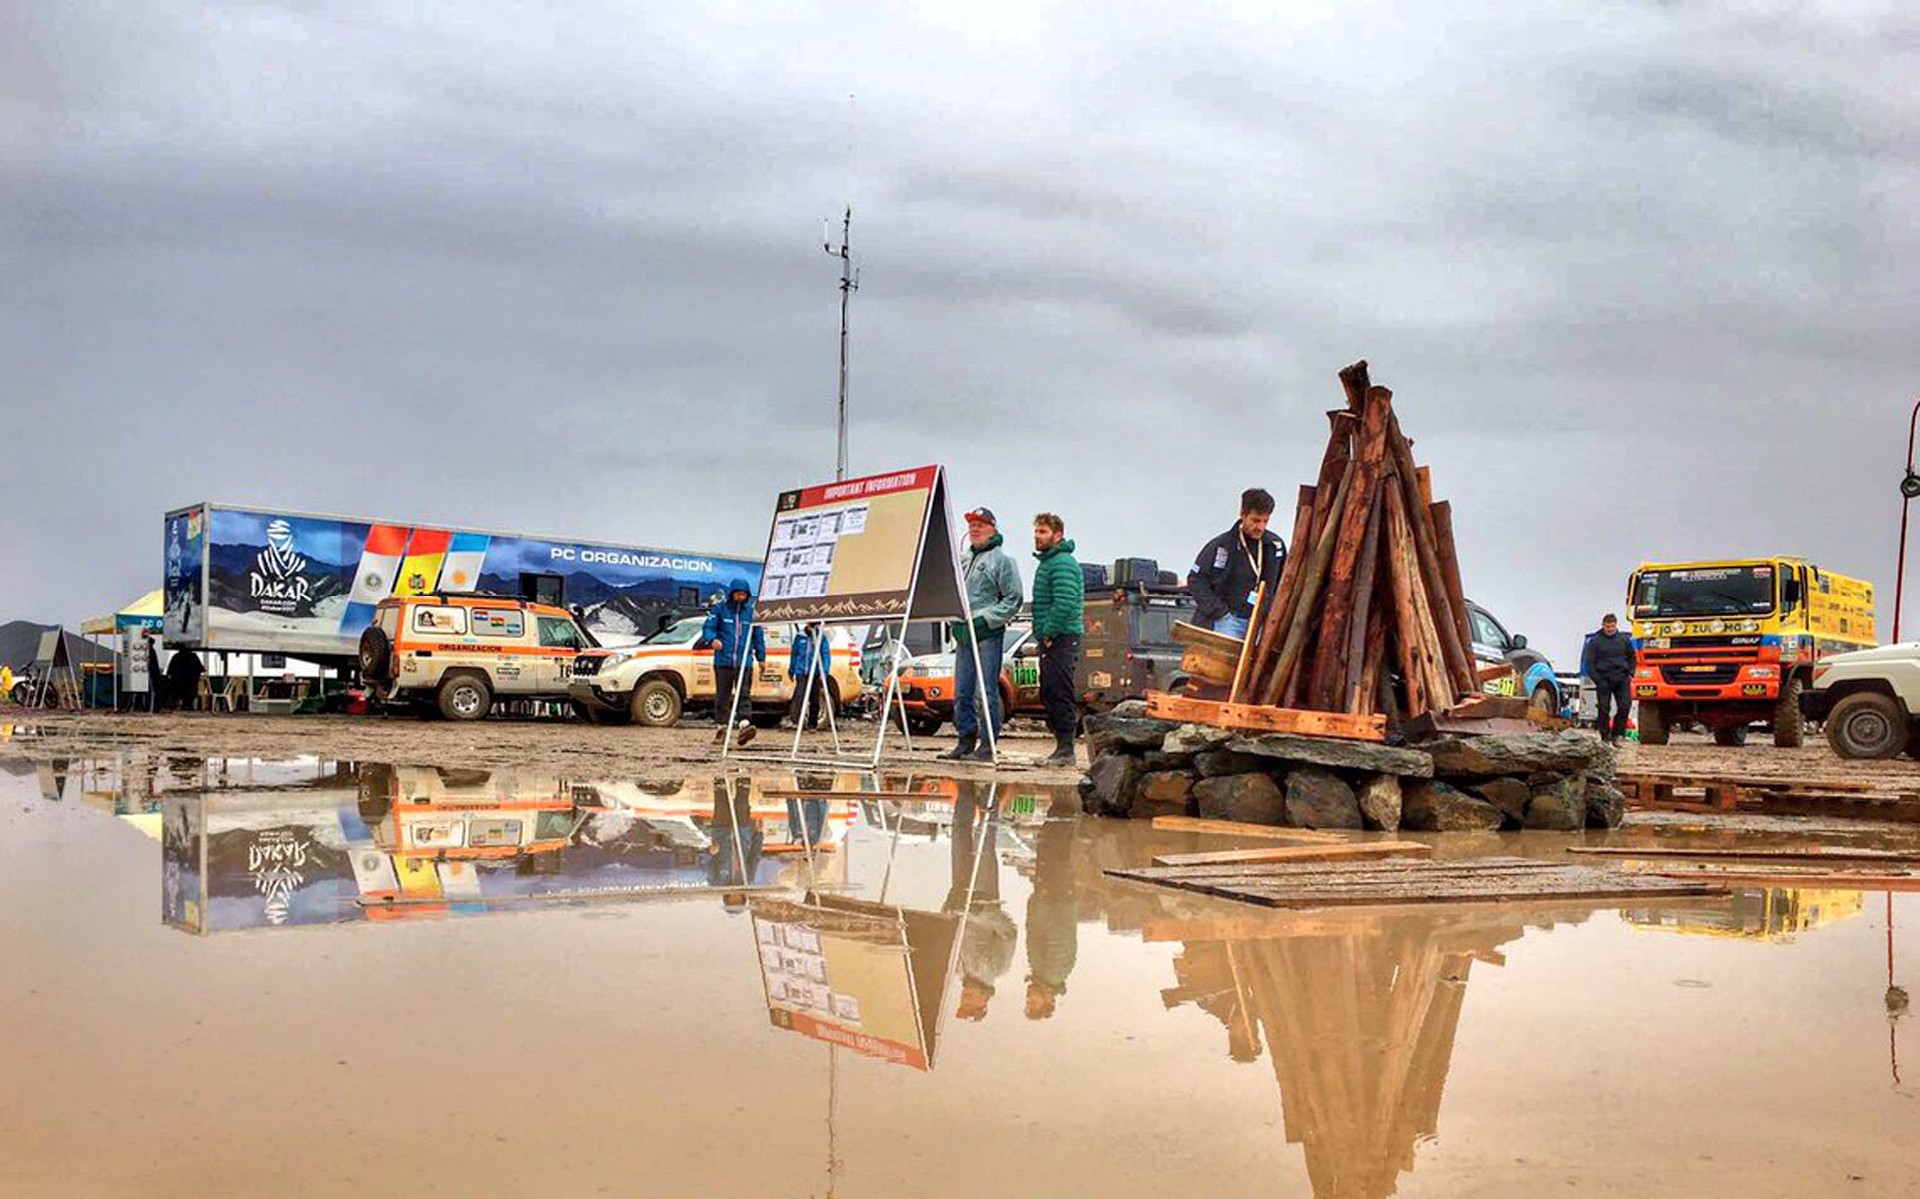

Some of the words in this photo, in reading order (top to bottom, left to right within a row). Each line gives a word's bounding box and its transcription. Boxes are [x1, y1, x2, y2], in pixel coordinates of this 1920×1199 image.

[824, 483, 865, 500] IMPORTANT
[865, 472, 918, 493] INFORMATION
[550, 548, 575, 560] PC
[581, 550, 713, 572] ORGANIZACION
[250, 572, 312, 601] DAKAR
[438, 643, 503, 653] ORGANIZACION
[1731, 637, 1760, 645] GINAF
